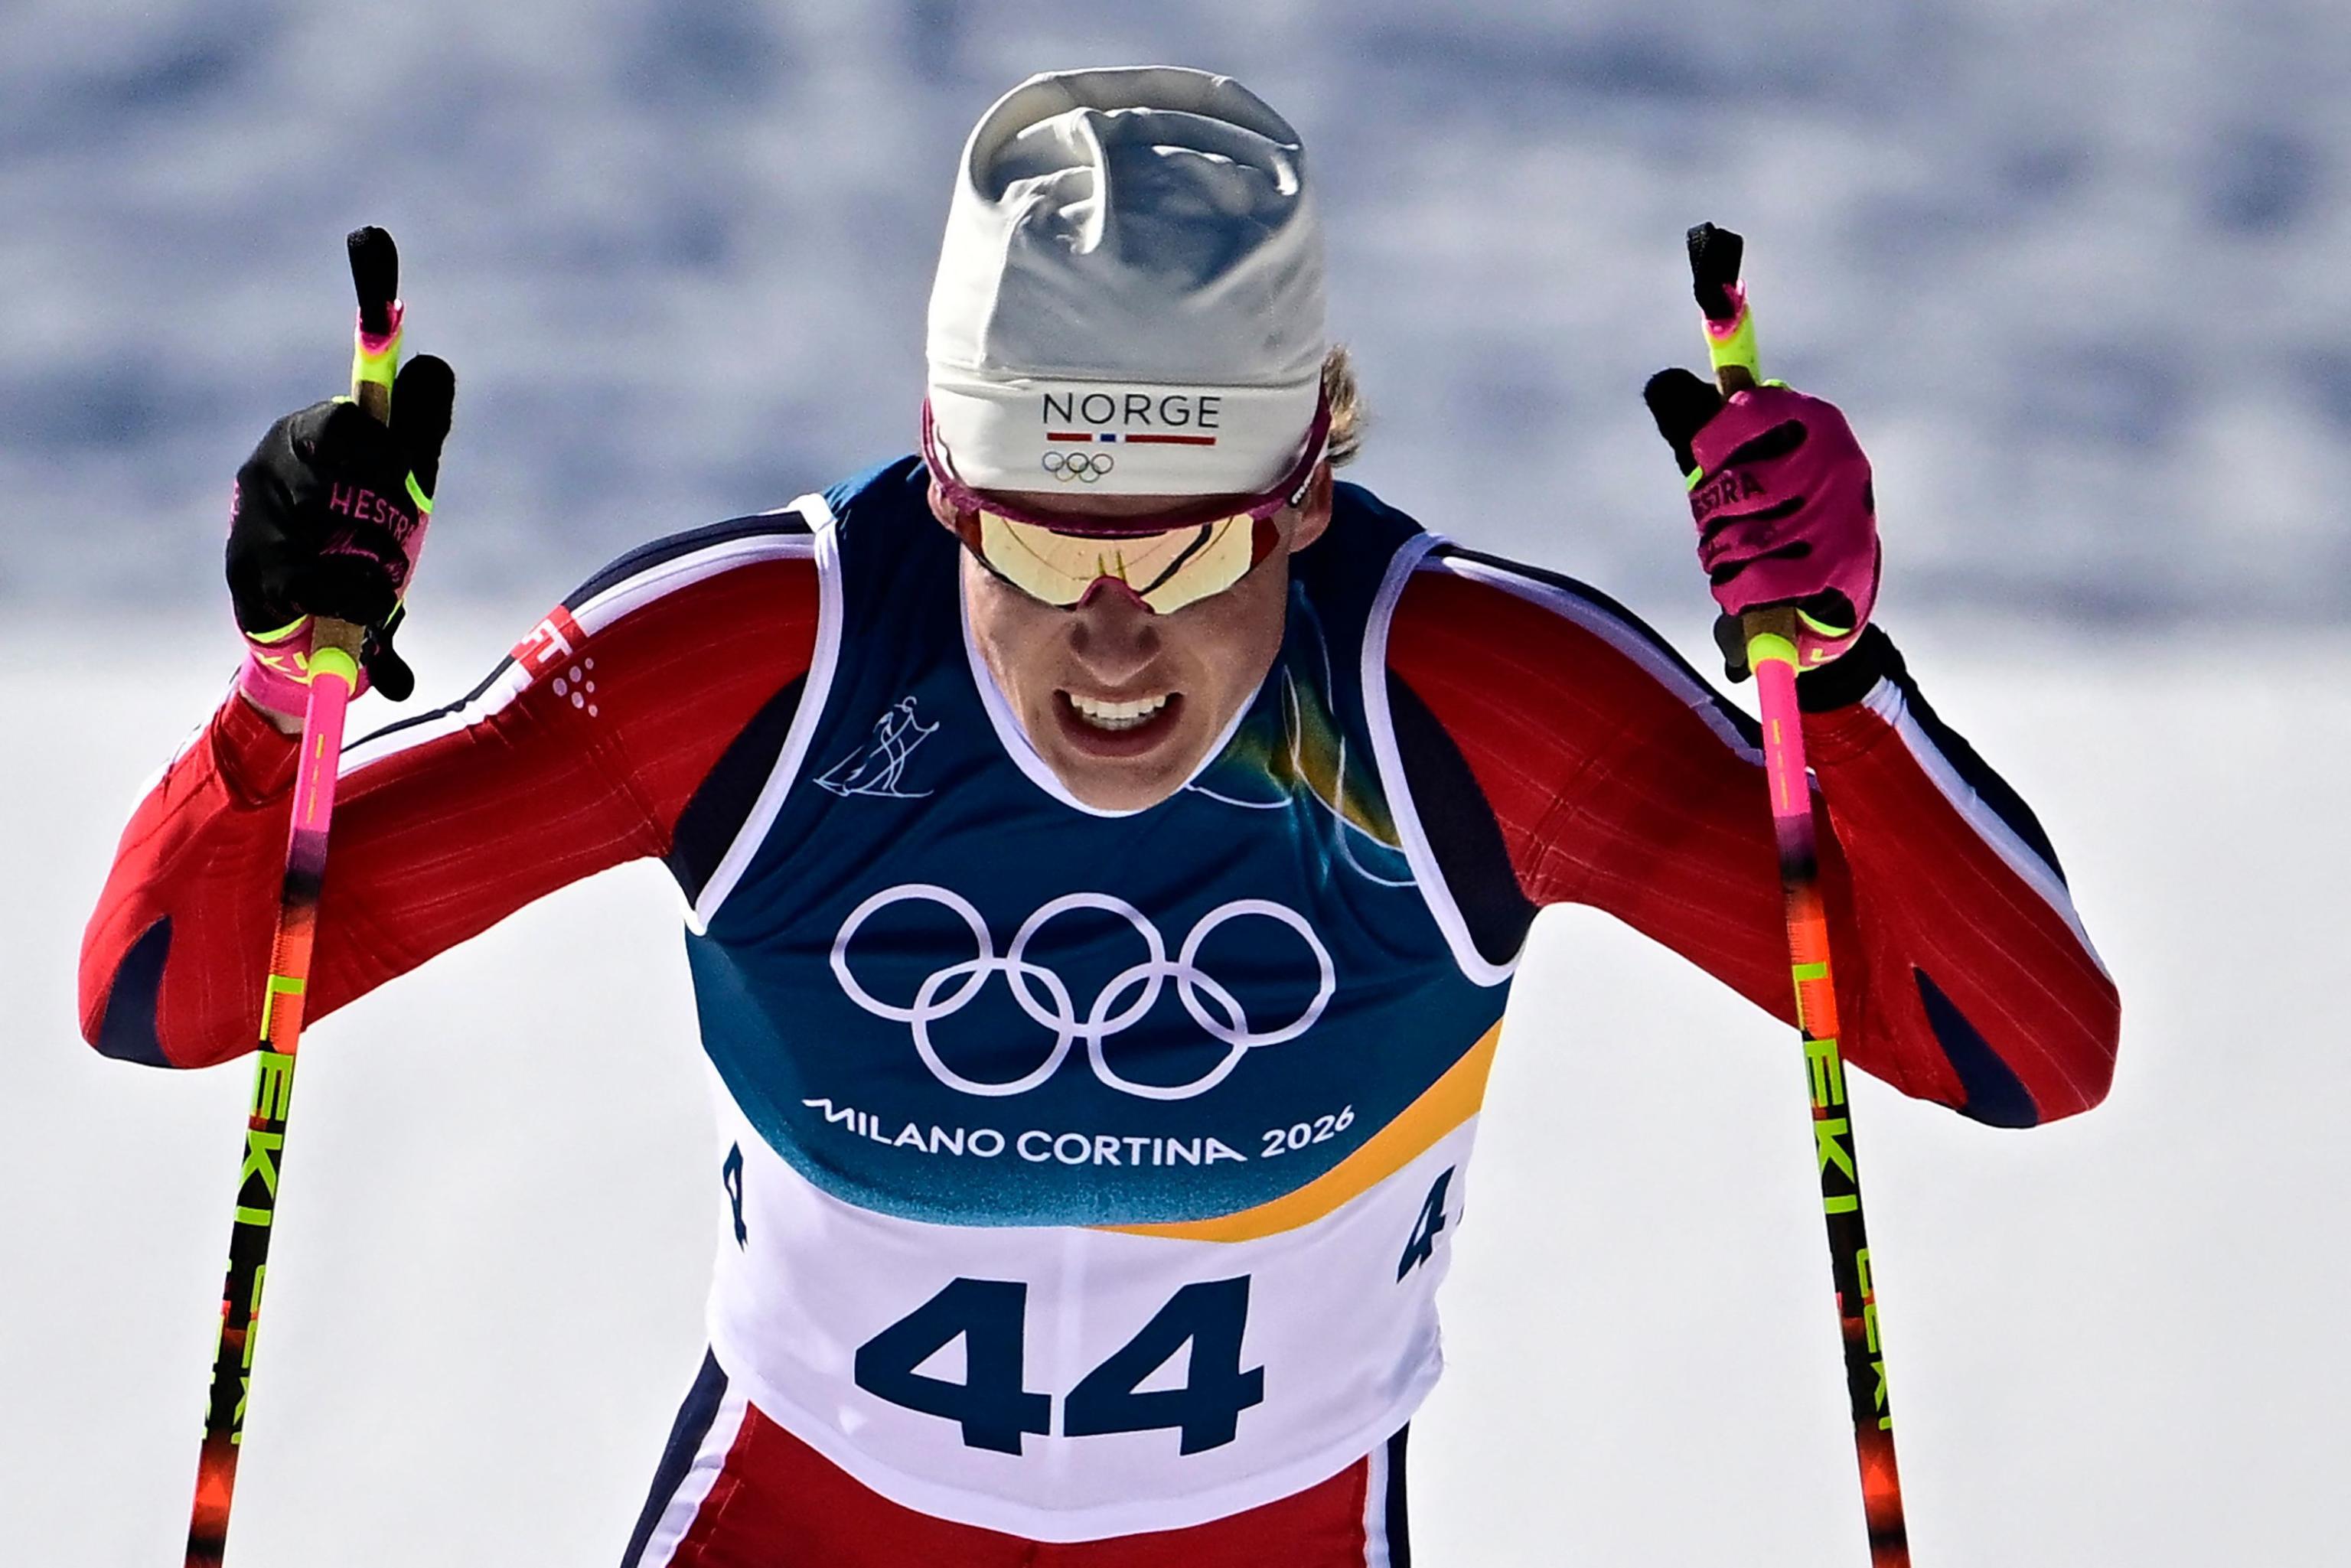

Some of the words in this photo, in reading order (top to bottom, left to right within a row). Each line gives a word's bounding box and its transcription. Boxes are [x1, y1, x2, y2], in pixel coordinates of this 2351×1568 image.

[1043, 393, 1221, 428] NORGE
[233, 973, 305, 1226] LEKI
[802, 1098, 1006, 1157] MILANO
[1016, 1130, 1248, 1165] CORTINA
[1260, 1104, 1355, 1158] 2026
[1792, 961, 1859, 1214] LEKI
[1396, 1164, 1465, 1284] 4
[854, 1273, 1265, 1457] 44
